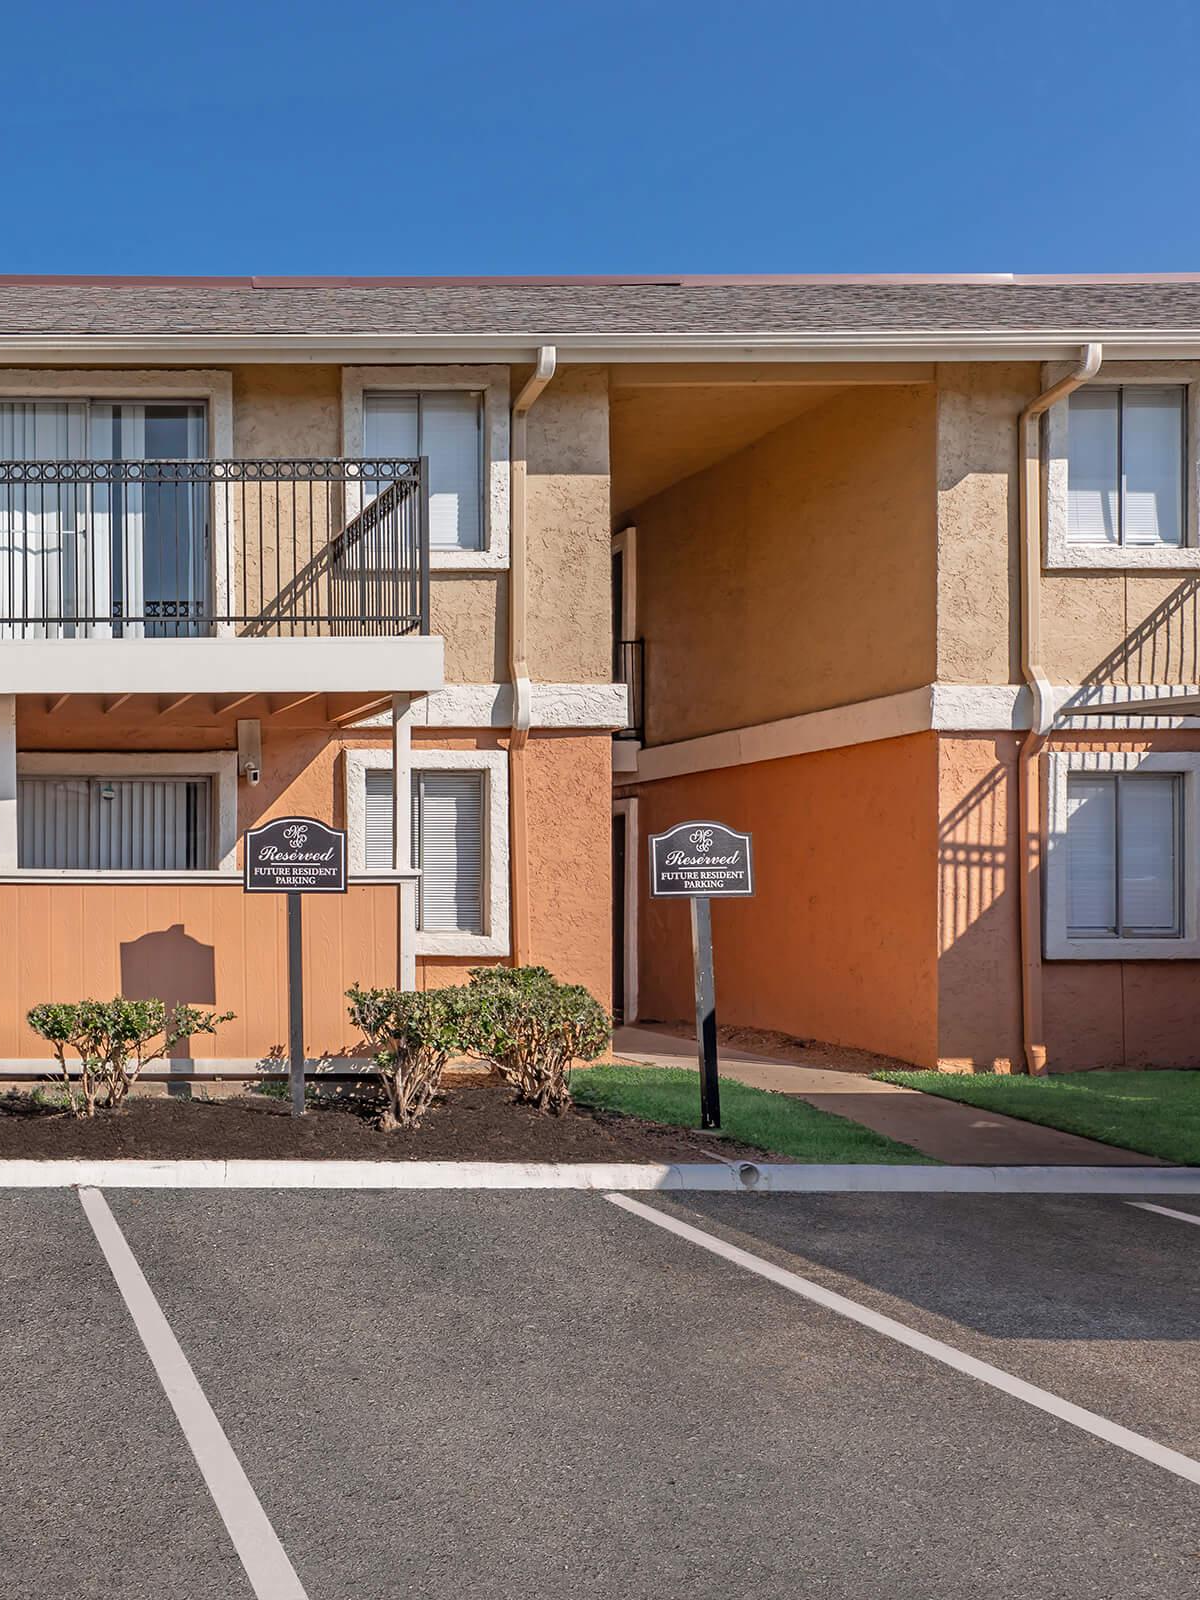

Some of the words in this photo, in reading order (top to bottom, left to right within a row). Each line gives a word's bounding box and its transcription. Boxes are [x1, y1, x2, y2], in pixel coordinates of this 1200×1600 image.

[259, 846, 334, 861] Reserved
[666, 851, 740, 865] Reserved
[661, 872, 699, 880] FUTURE
[701, 871, 744, 879] RESIDENT
[684, 880, 724, 888] PARKING
